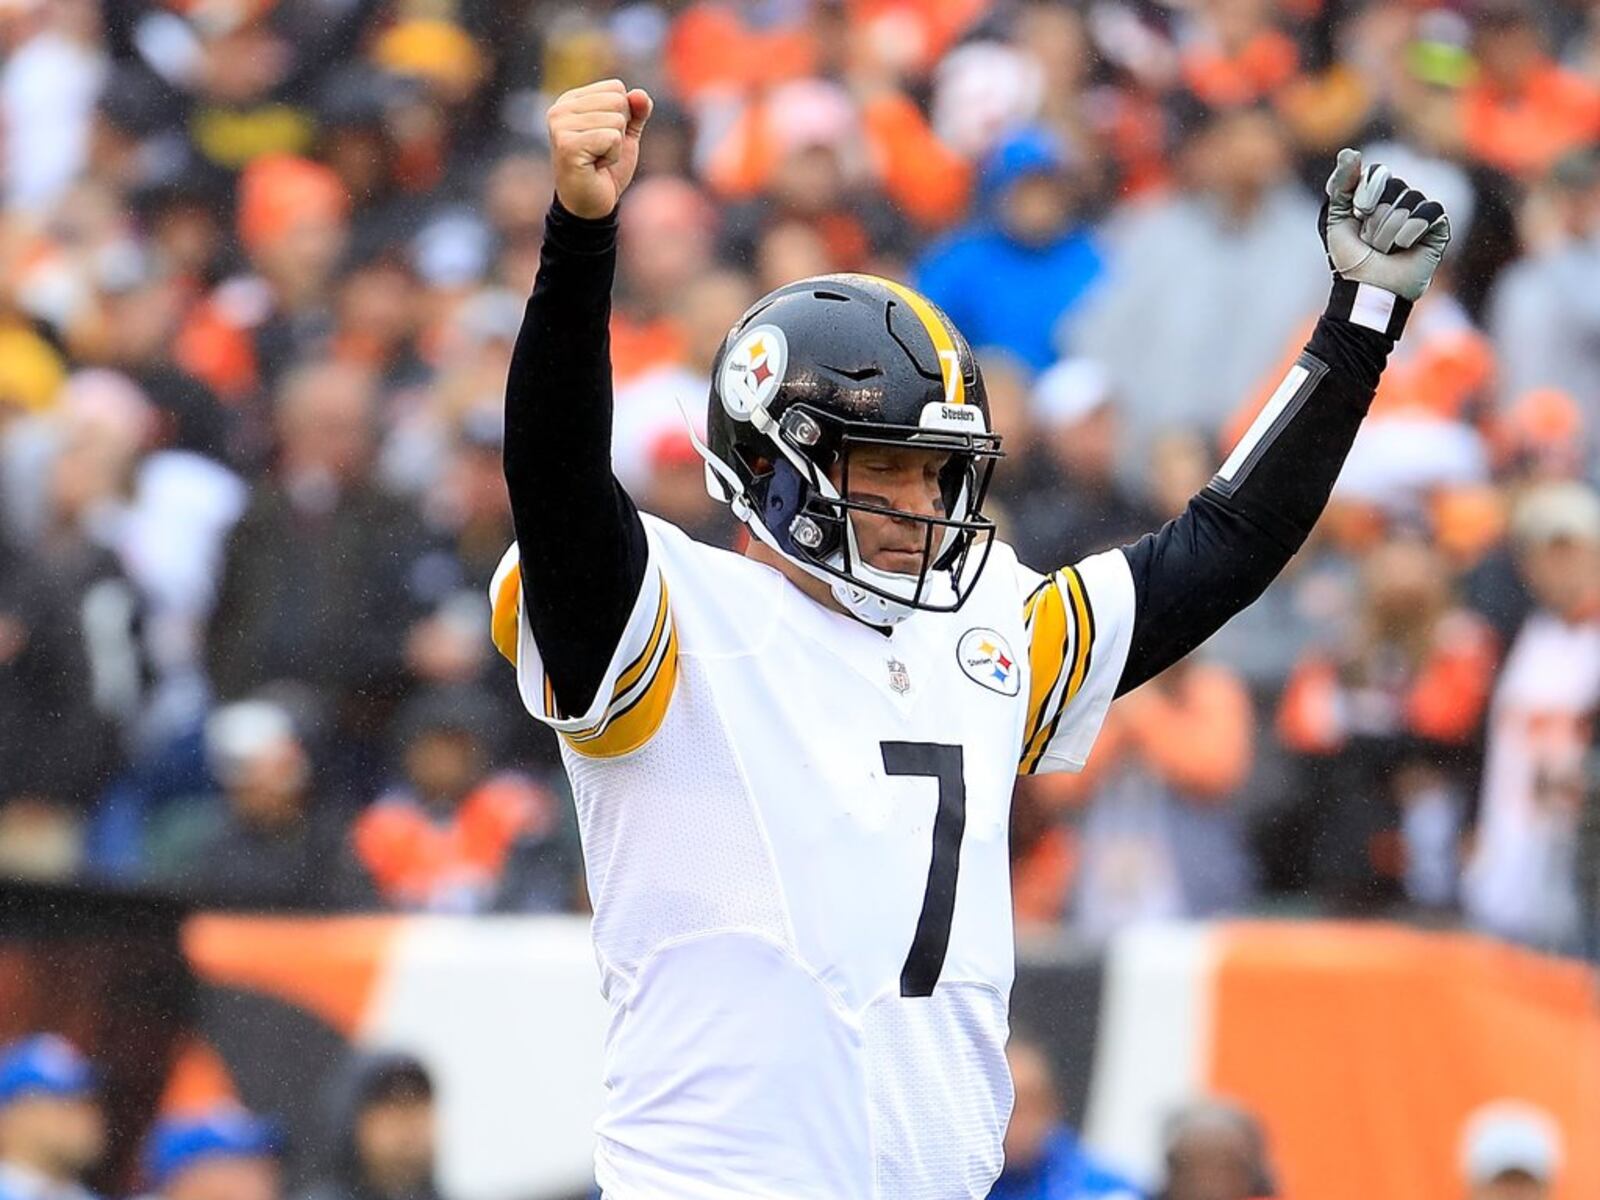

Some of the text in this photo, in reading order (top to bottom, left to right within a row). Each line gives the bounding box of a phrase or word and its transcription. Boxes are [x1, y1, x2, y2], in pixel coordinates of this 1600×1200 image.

[939, 350, 960, 402] 7
[941, 406, 975, 421] Steelers
[880, 740, 966, 997] 7
